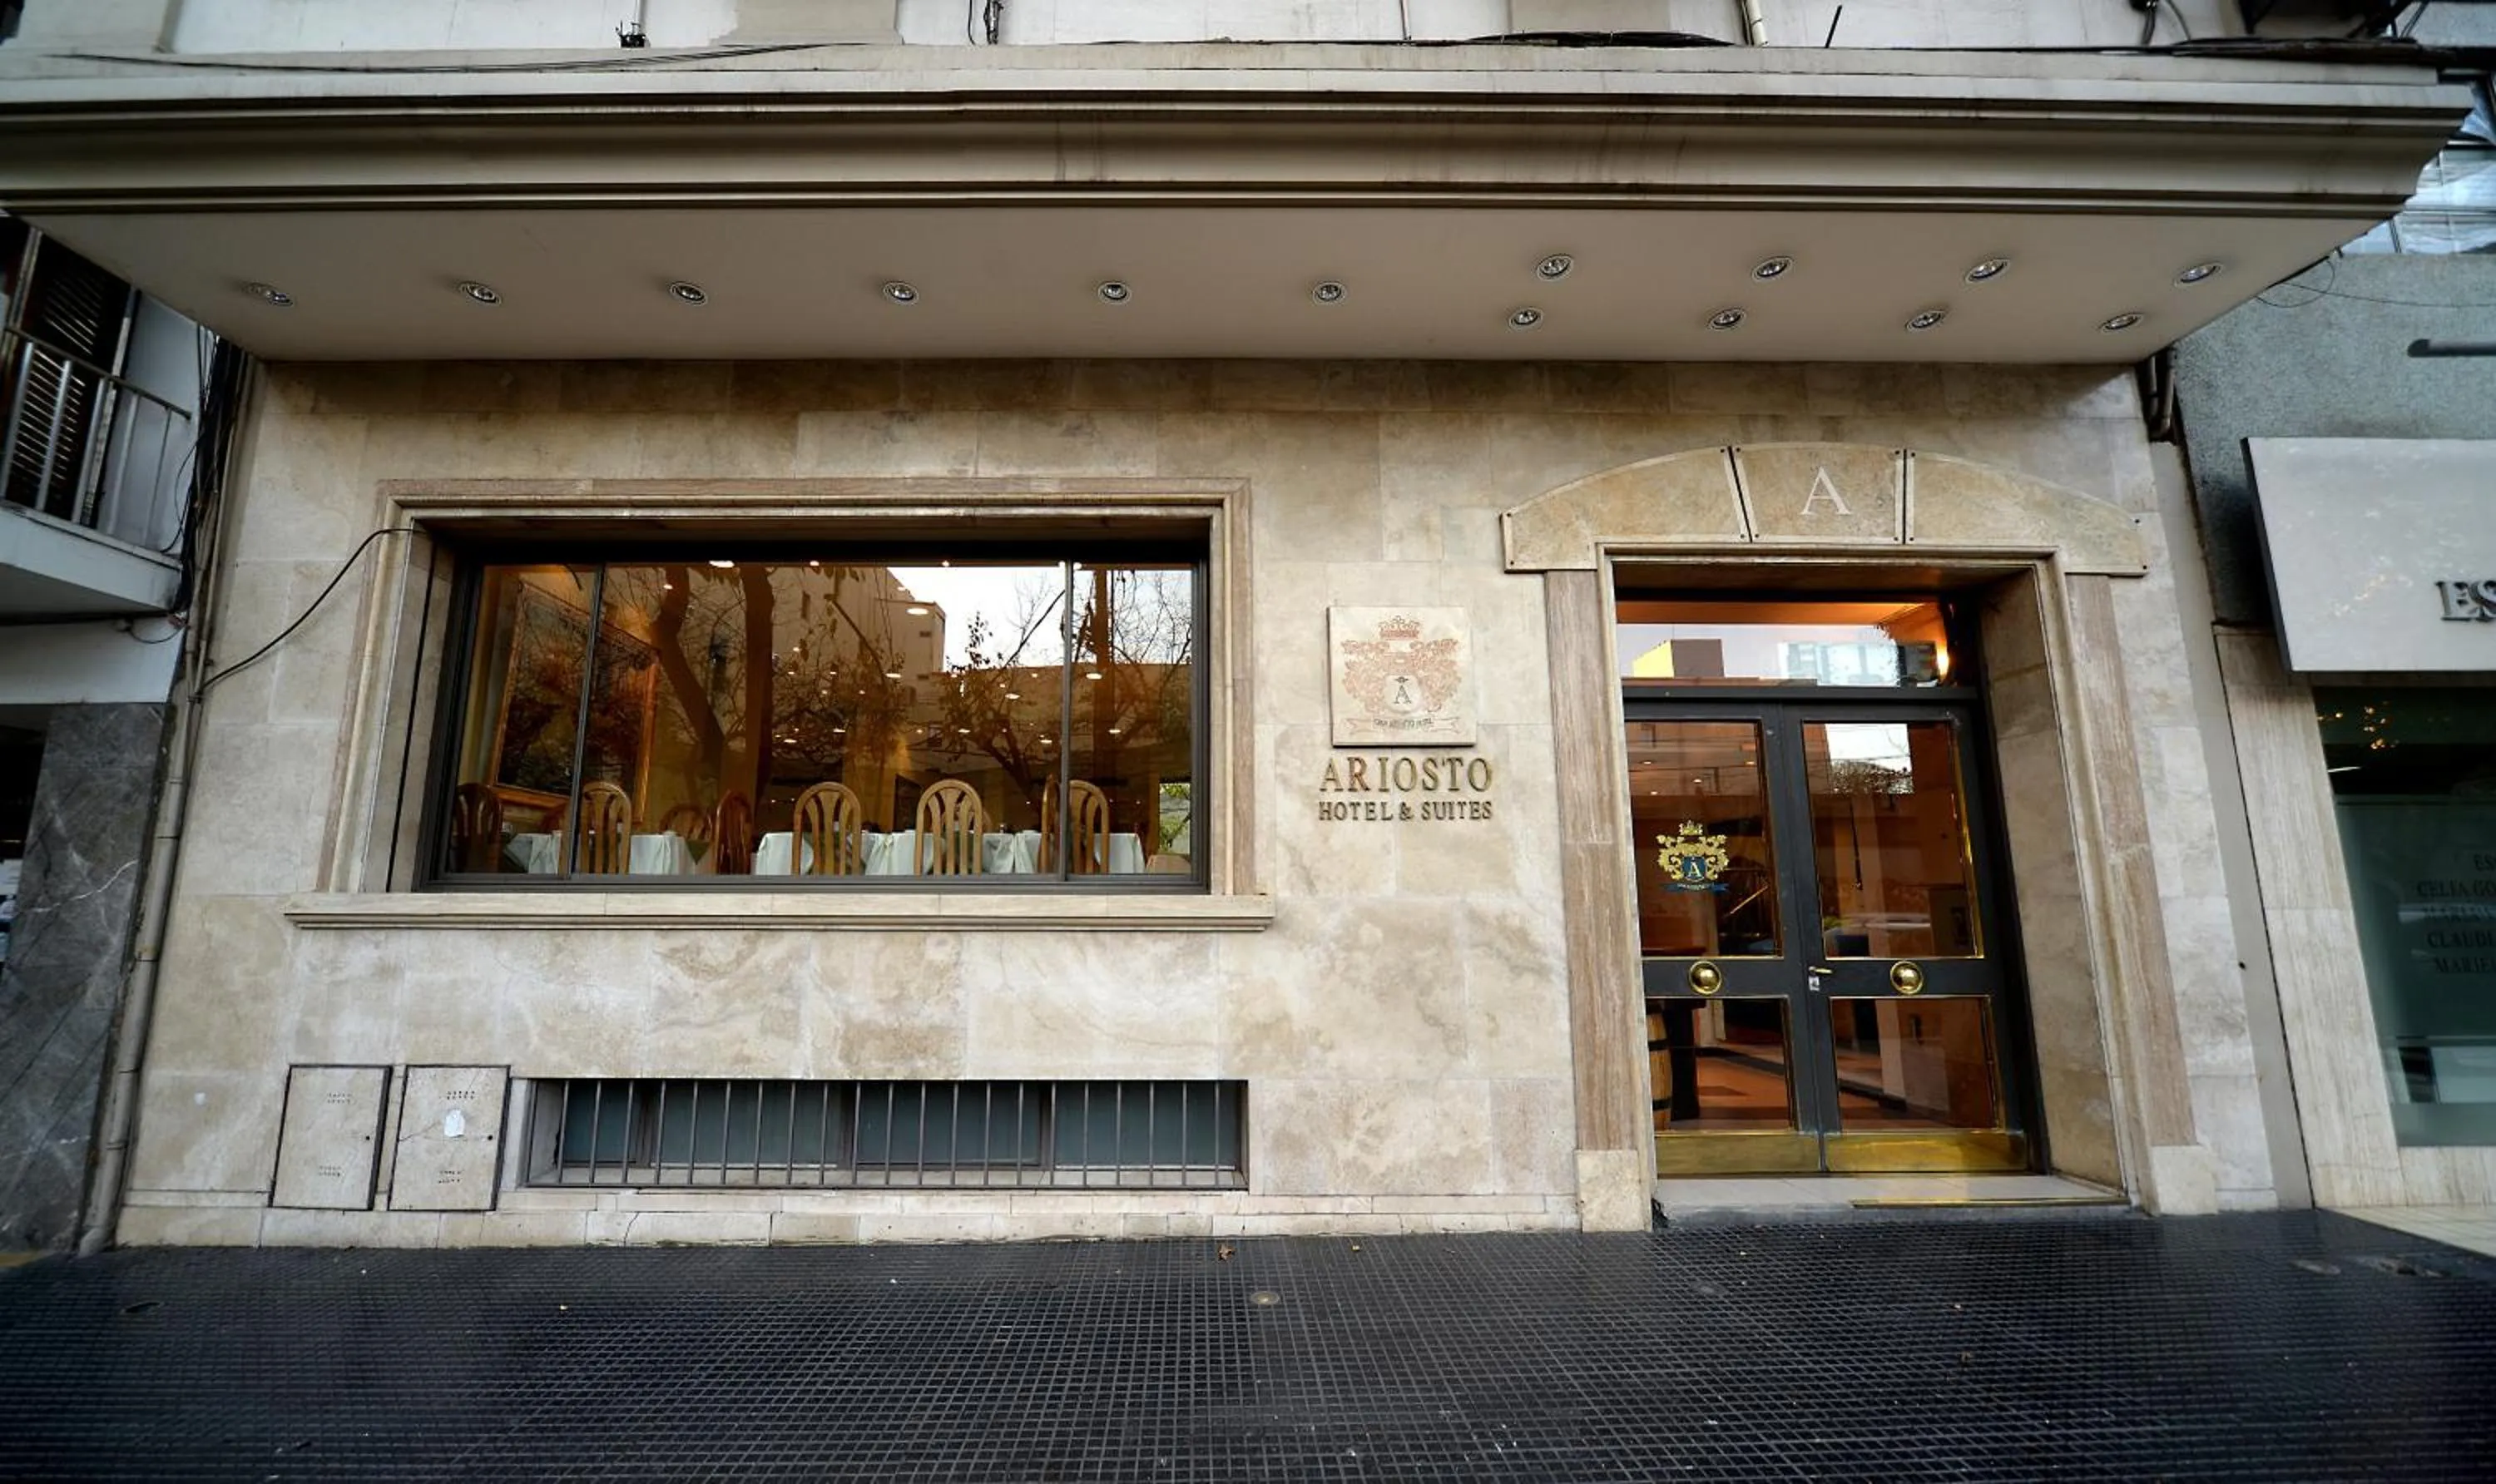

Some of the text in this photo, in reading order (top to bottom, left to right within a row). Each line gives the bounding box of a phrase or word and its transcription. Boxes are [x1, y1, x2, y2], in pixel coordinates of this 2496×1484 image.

[1800, 465, 1852, 516] A
[2434, 581, 2496, 622] ES
[1393, 684, 1413, 705] A
[1319, 756, 1493, 791] ARIOSTO
[1319, 801, 1493, 821] HOTEL & SUITES
[1687, 861, 1703, 877] A
